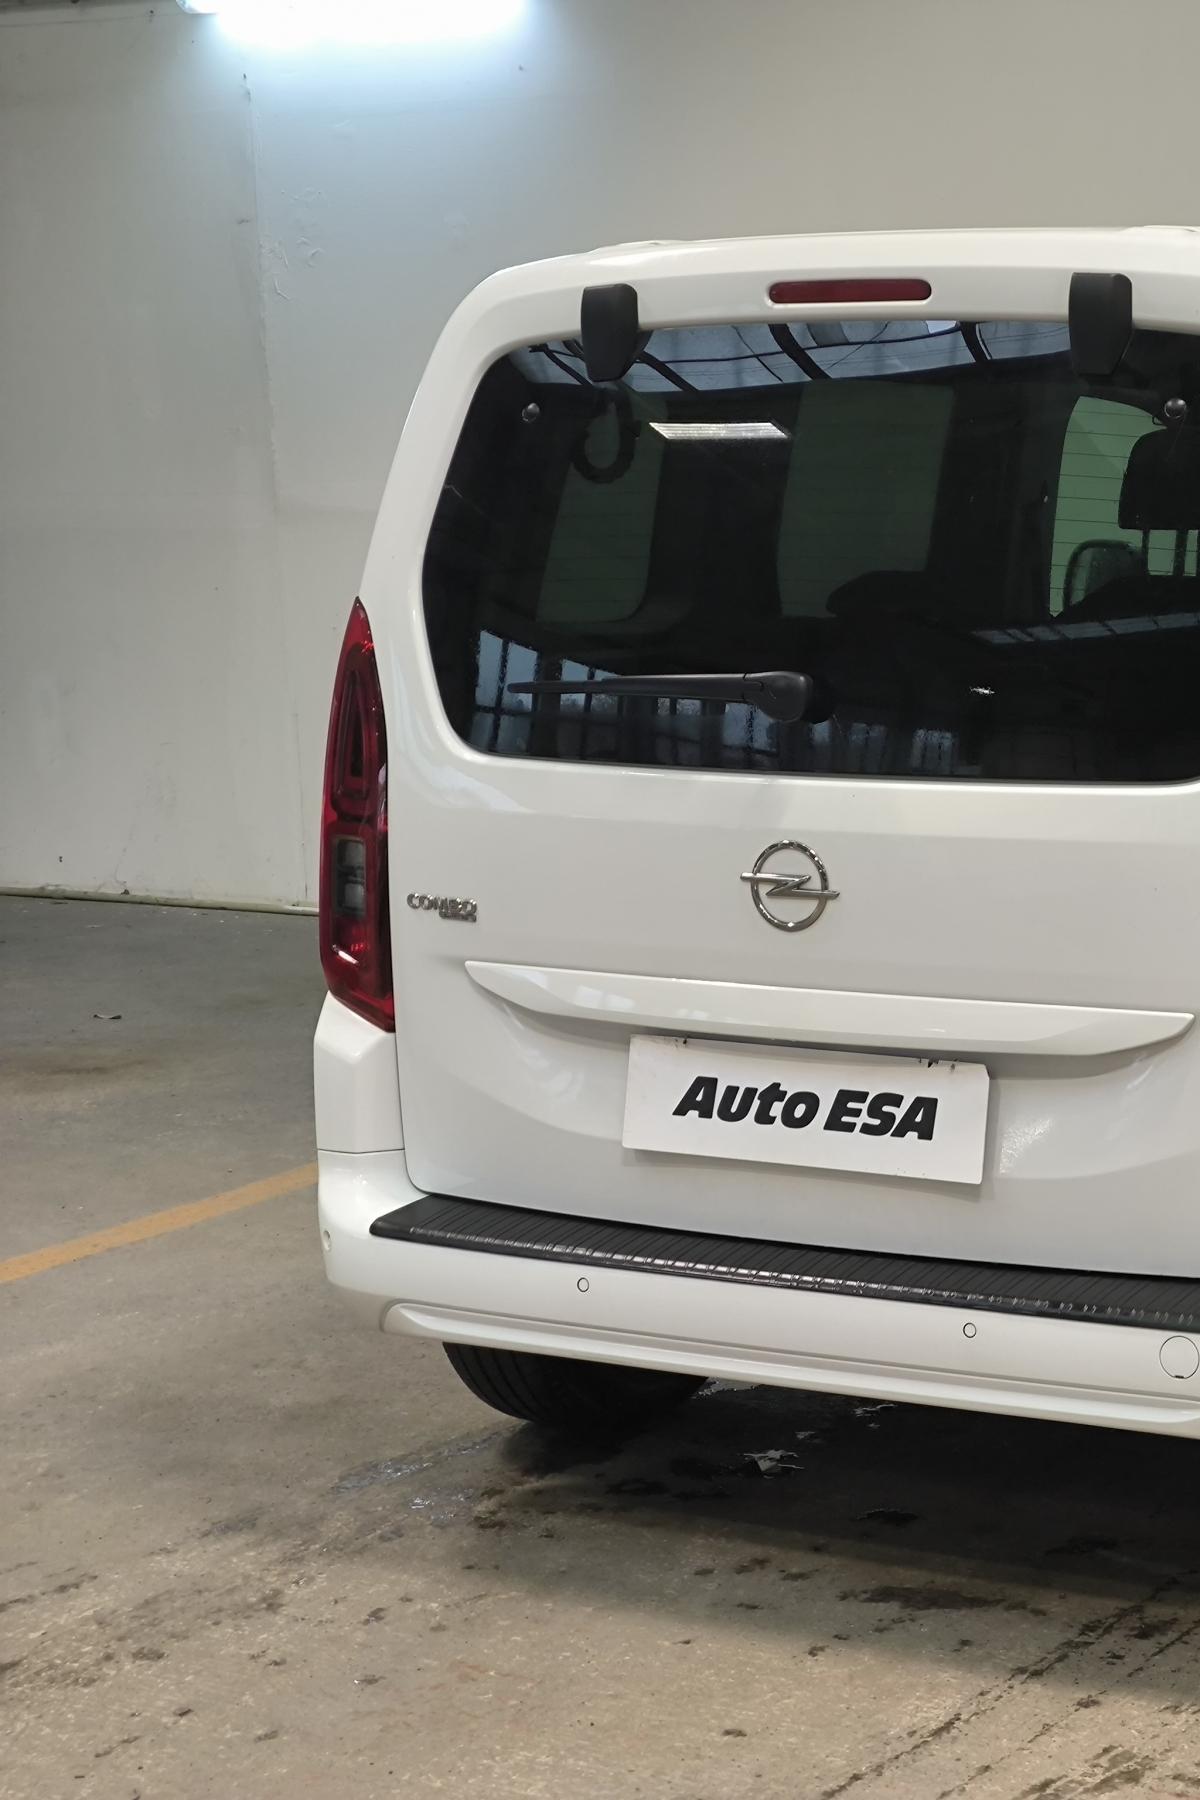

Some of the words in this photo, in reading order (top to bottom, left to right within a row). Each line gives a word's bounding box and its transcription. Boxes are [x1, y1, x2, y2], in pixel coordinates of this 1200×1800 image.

[406, 893, 477, 915] COMBO
[672, 1075, 820, 1129] Auto
[823, 1089, 938, 1141] ESA
